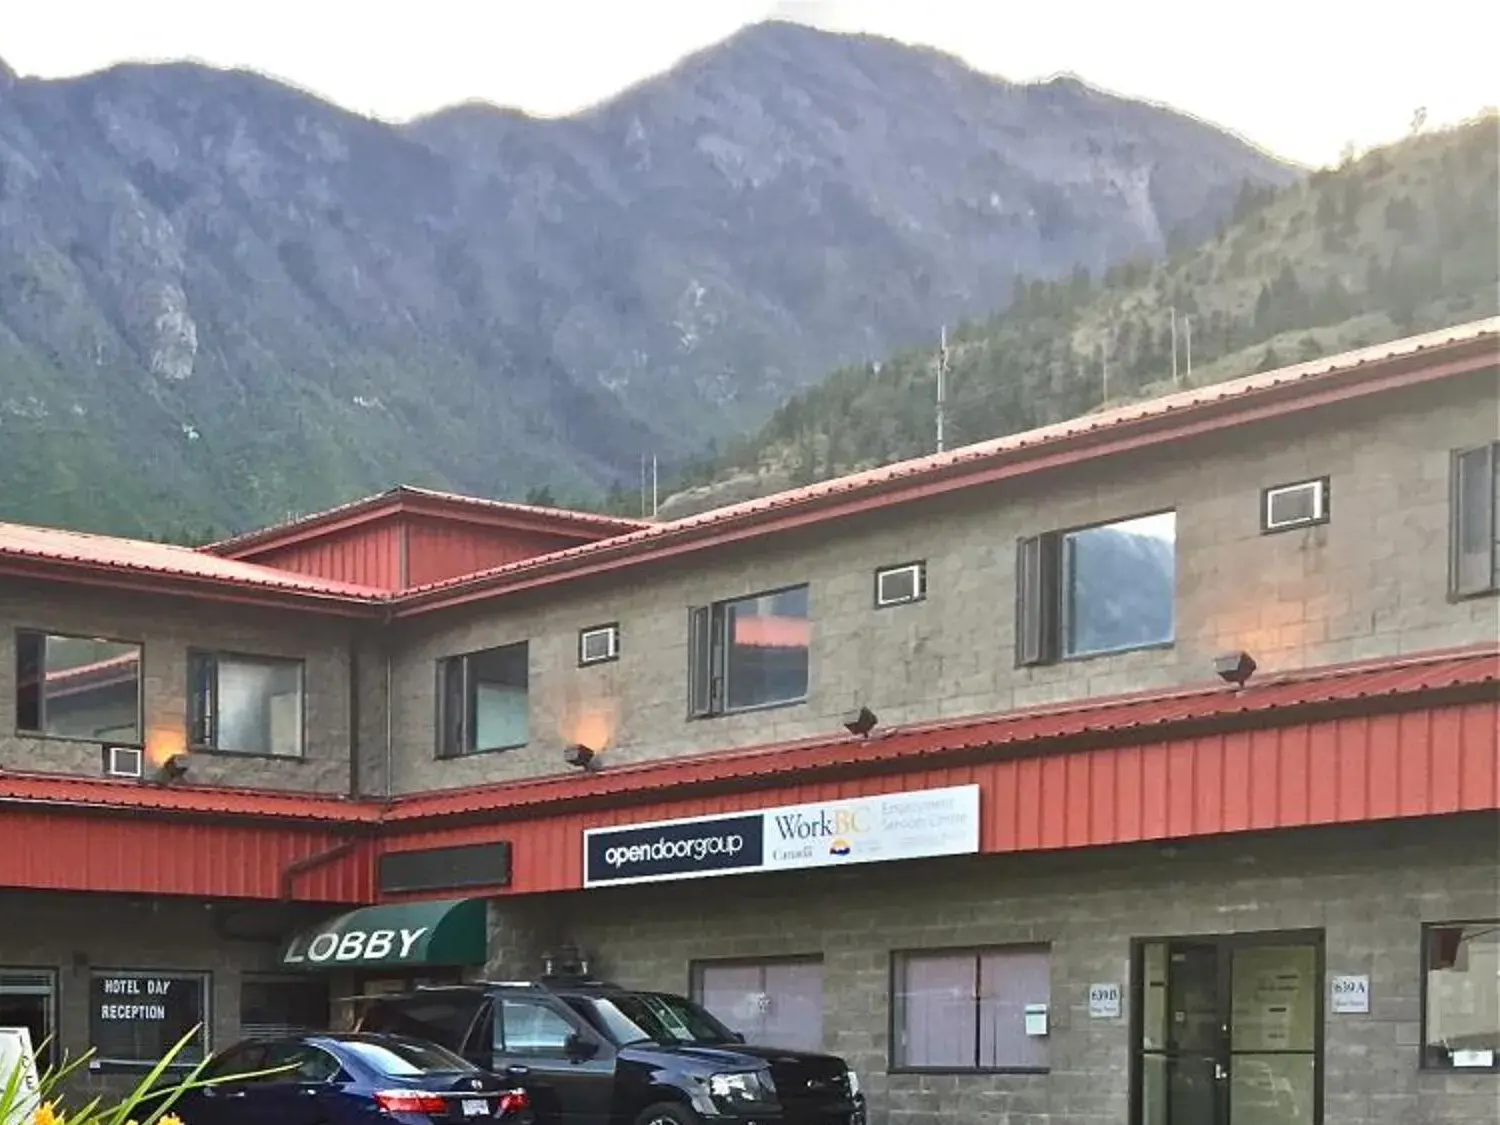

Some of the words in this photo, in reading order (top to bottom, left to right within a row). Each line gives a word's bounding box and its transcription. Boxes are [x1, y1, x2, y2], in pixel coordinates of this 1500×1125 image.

[775, 807, 871, 841] WorkBC
[605, 834, 743, 869] opendoorgroup
[284, 926, 428, 963] LOBBY
[105, 979, 140, 994] HOTEL
[147, 980, 171, 995] DAY
[101, 1005, 165, 1019] RECEPTION
